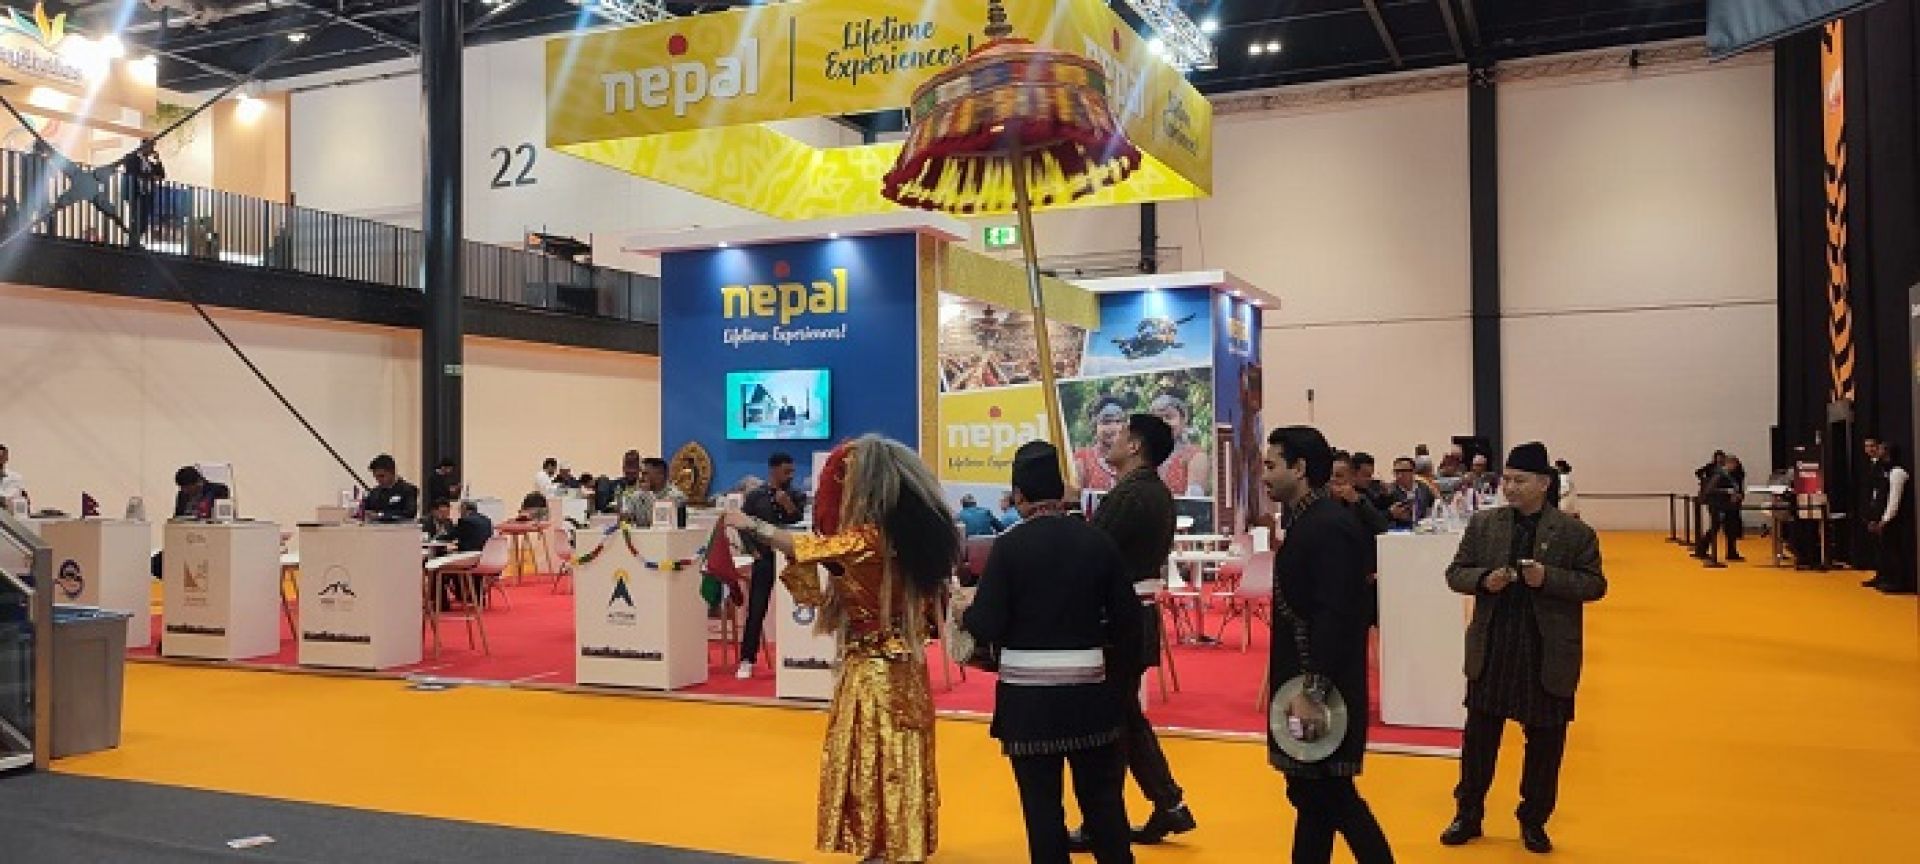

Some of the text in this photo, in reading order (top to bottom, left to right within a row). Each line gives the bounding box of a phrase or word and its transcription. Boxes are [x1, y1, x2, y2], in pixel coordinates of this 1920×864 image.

[843, 16, 934, 56] Lifetime
[600, 37, 759, 117] nepal
[490, 142, 537, 189] 22
[721, 267, 849, 325] nepal
[947, 412, 1049, 456] nepal
